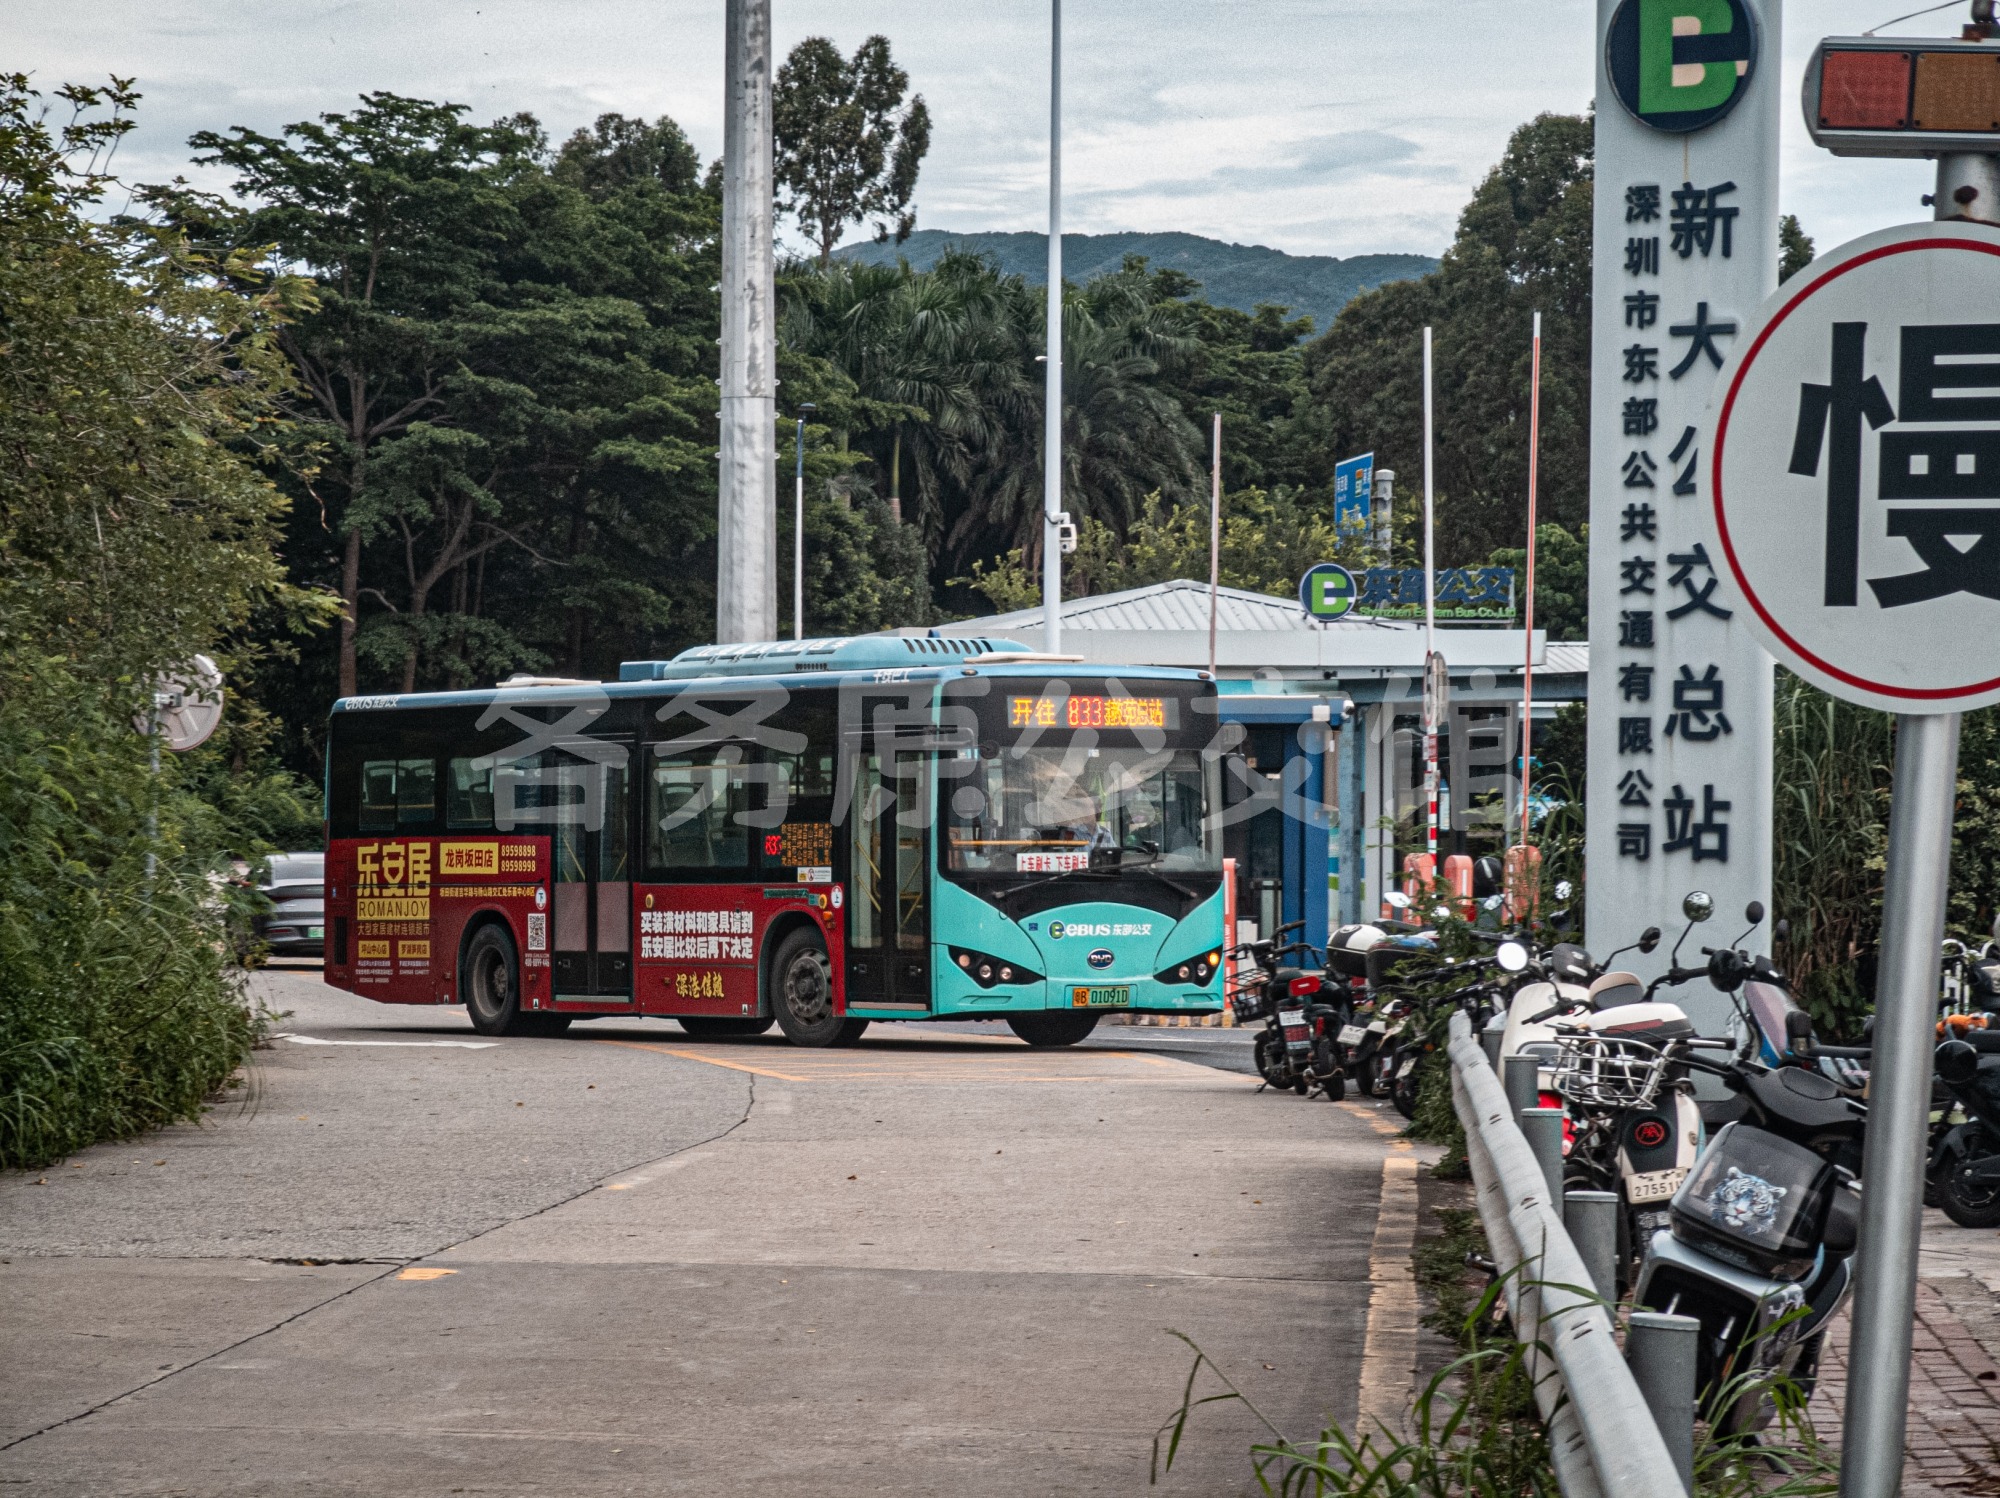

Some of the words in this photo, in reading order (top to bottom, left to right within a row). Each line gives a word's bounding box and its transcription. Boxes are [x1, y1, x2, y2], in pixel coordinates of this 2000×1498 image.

[1788, 321, 2000, 609] 慢
[1616, 185, 1661, 862] 深圳市东部公共交通有限公司
[1359, 567, 1515, 603] 东部公交
[1359, 606, 1412, 617] Shenzhen
[1413, 606, 1453, 617] Eatern
[1012, 697, 1057, 725] 开往
[1068, 697, 1102, 727] 833
[445, 849, 493, 867] 龙岗坂田店
[501, 845, 536, 857] 89598898
[357, 842, 431, 896] 乐安居
[1021, 856, 1051, 872] 上车刷卡
[1056, 856, 1087, 872] 下车刷卡
[359, 900, 428, 917] ROMANJOY
[641, 911, 753, 934] 买装潢材料和家具请到
[1113, 923, 1152, 936] 东部公交
[641, 936, 753, 959] 乐安居比较后再下决定
[1091, 953, 1112, 963] BYD
[1091, 987, 1129, 1004] 01091D
